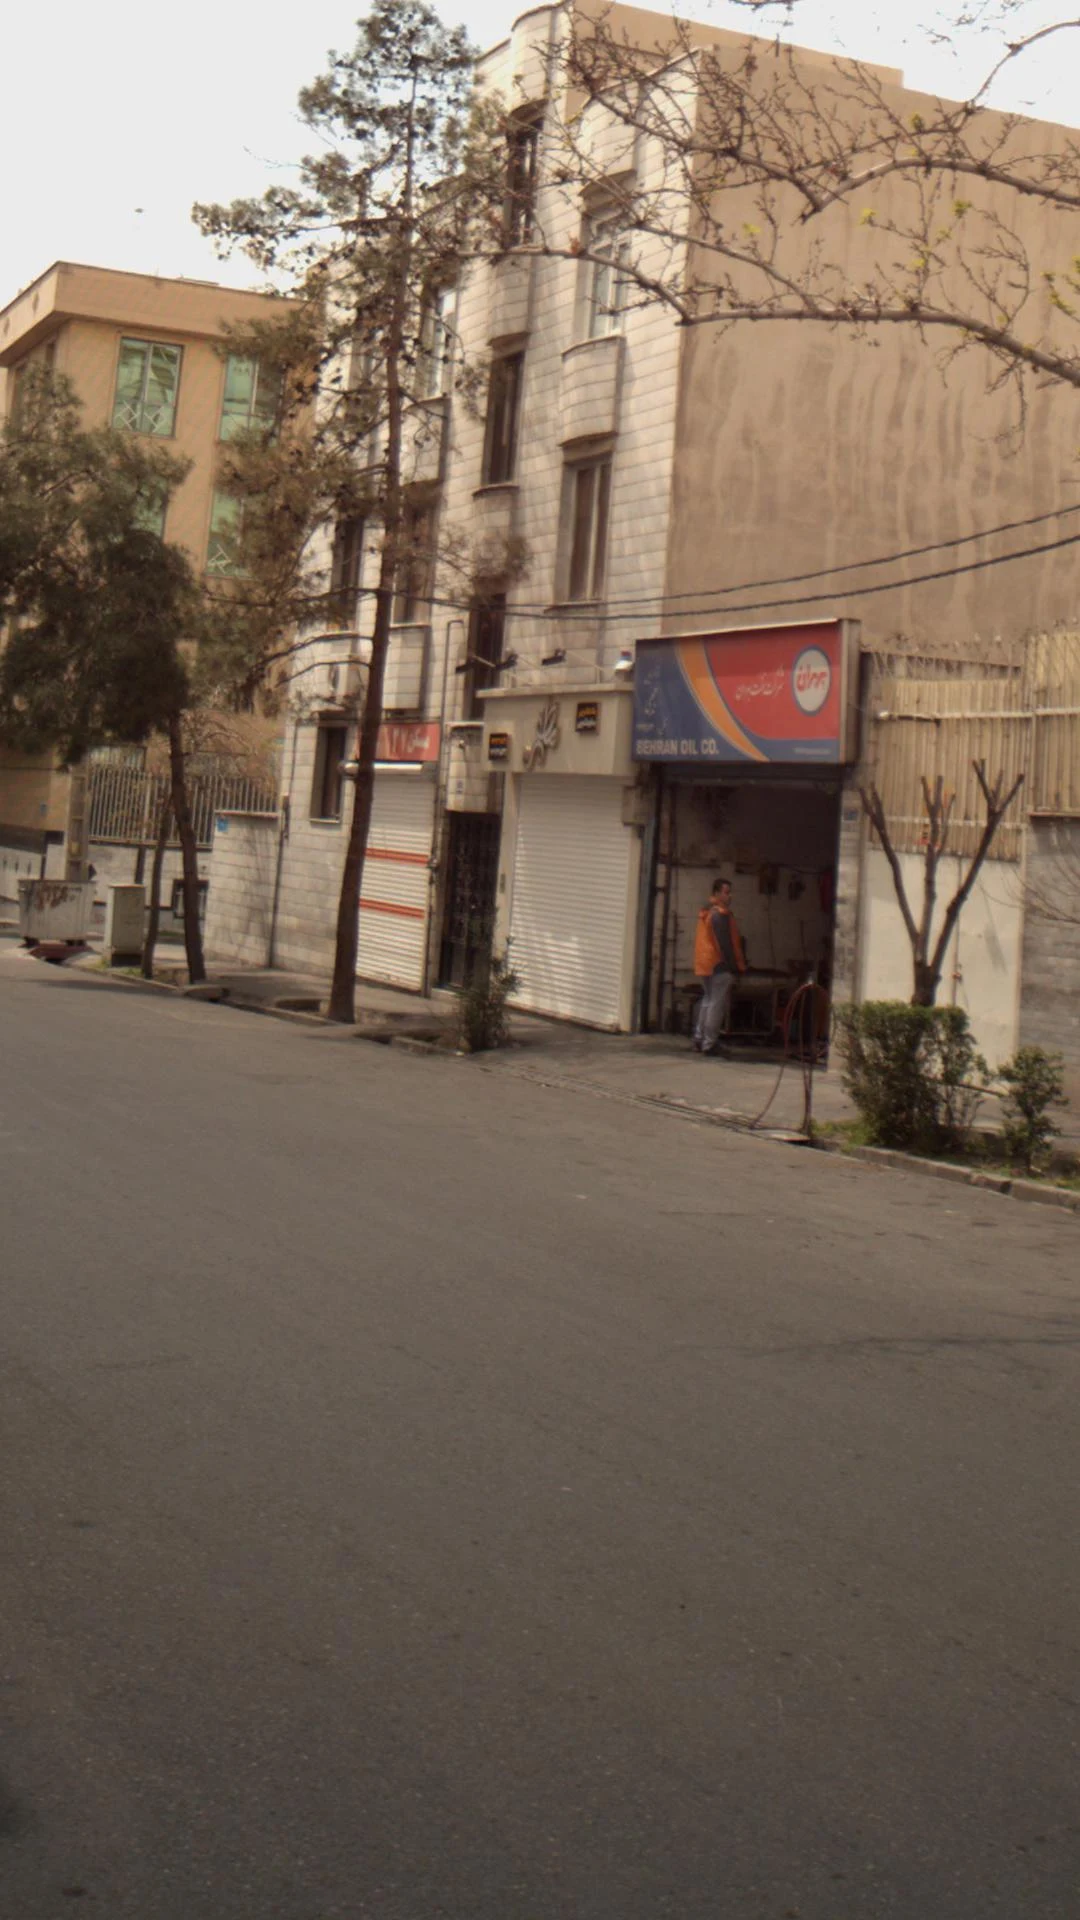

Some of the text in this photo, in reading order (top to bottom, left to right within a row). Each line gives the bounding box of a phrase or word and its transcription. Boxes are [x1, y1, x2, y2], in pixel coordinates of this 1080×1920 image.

[636, 738, 720, 755] BEHRAN OIL CO.
